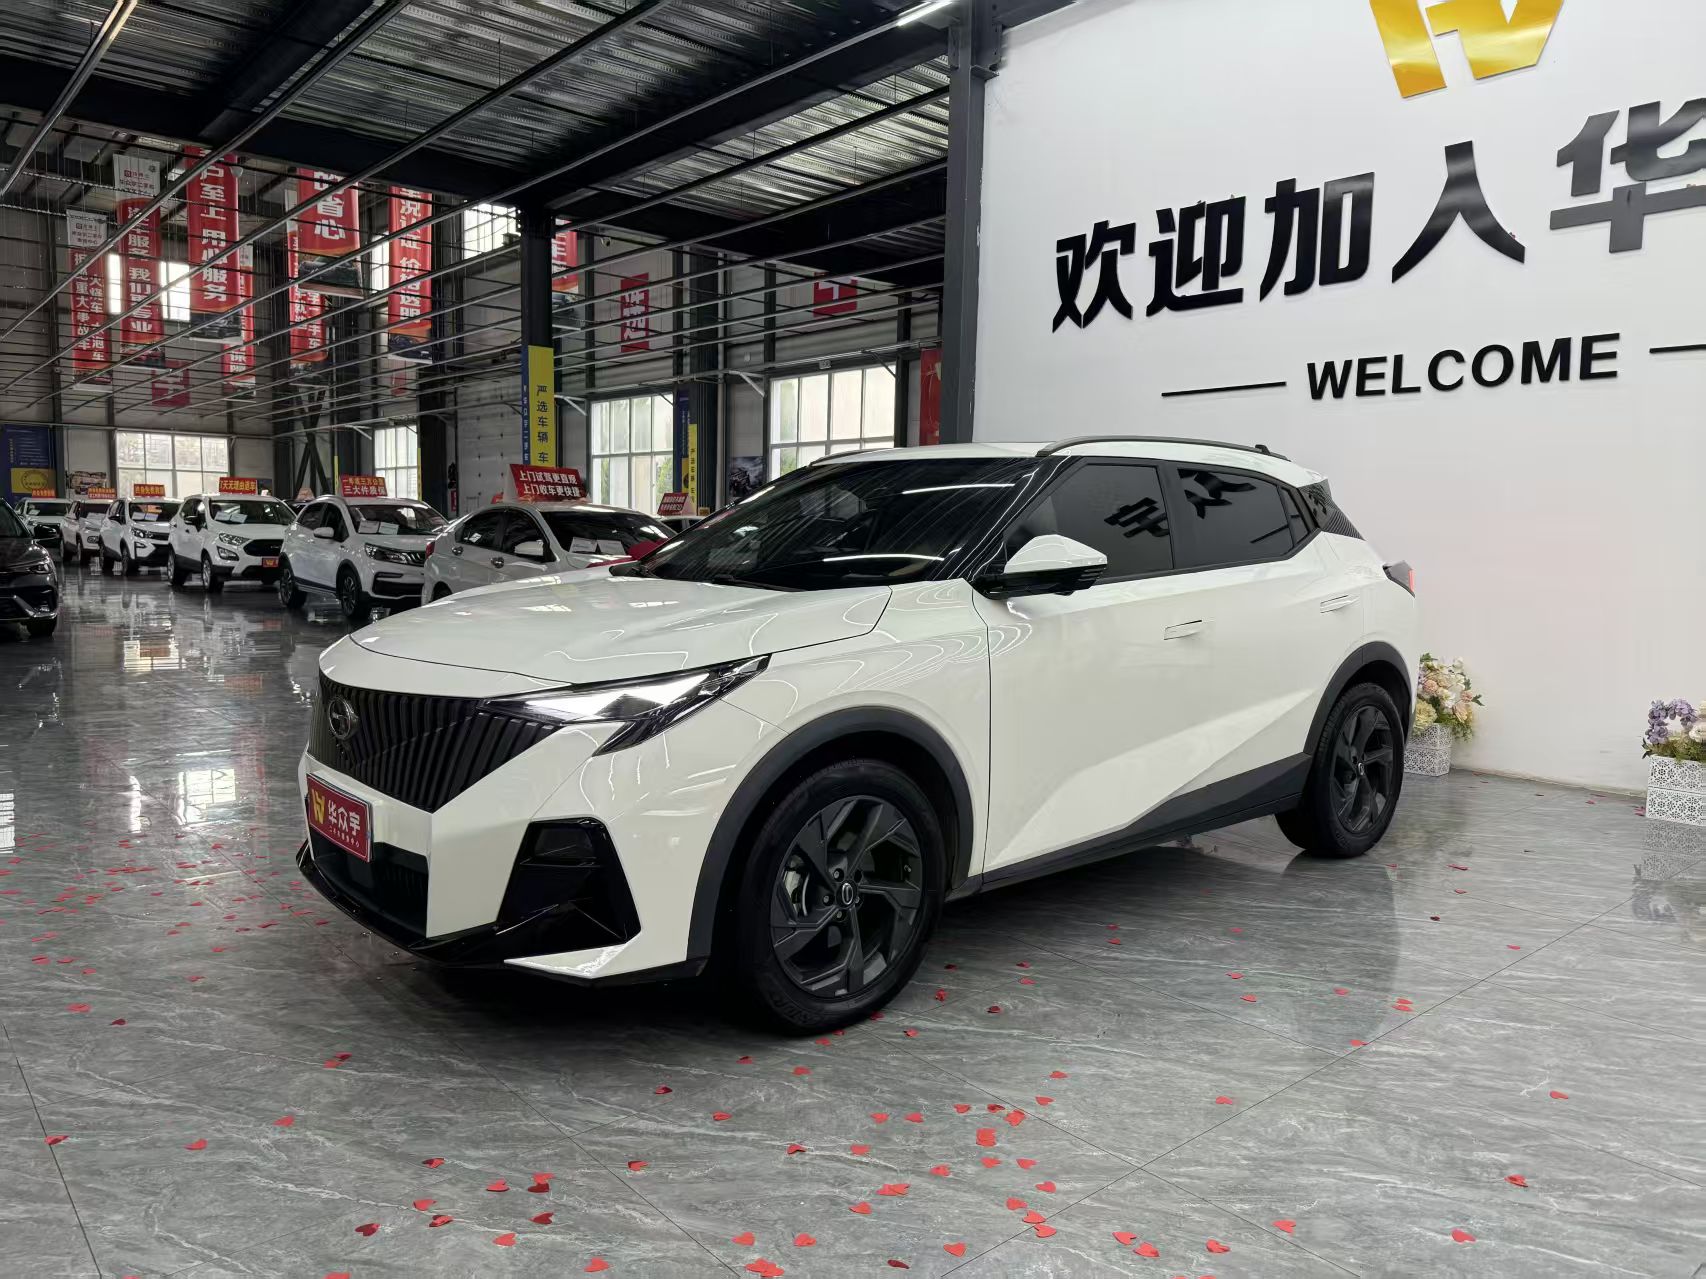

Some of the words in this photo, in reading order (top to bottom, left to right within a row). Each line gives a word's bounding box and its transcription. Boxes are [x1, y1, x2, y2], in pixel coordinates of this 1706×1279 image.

[201, 229, 228, 302] 用心服务
[129, 267, 153, 333] 我们更专业
[1306, 332, 1620, 400] WELCOME
[536, 384, 549, 444] 严选车辆
[519, 469, 578, 485] 上门试驾更直观
[523, 483, 581, 498] 上门收车更快捷
[327, 799, 361, 837] 华众宇
